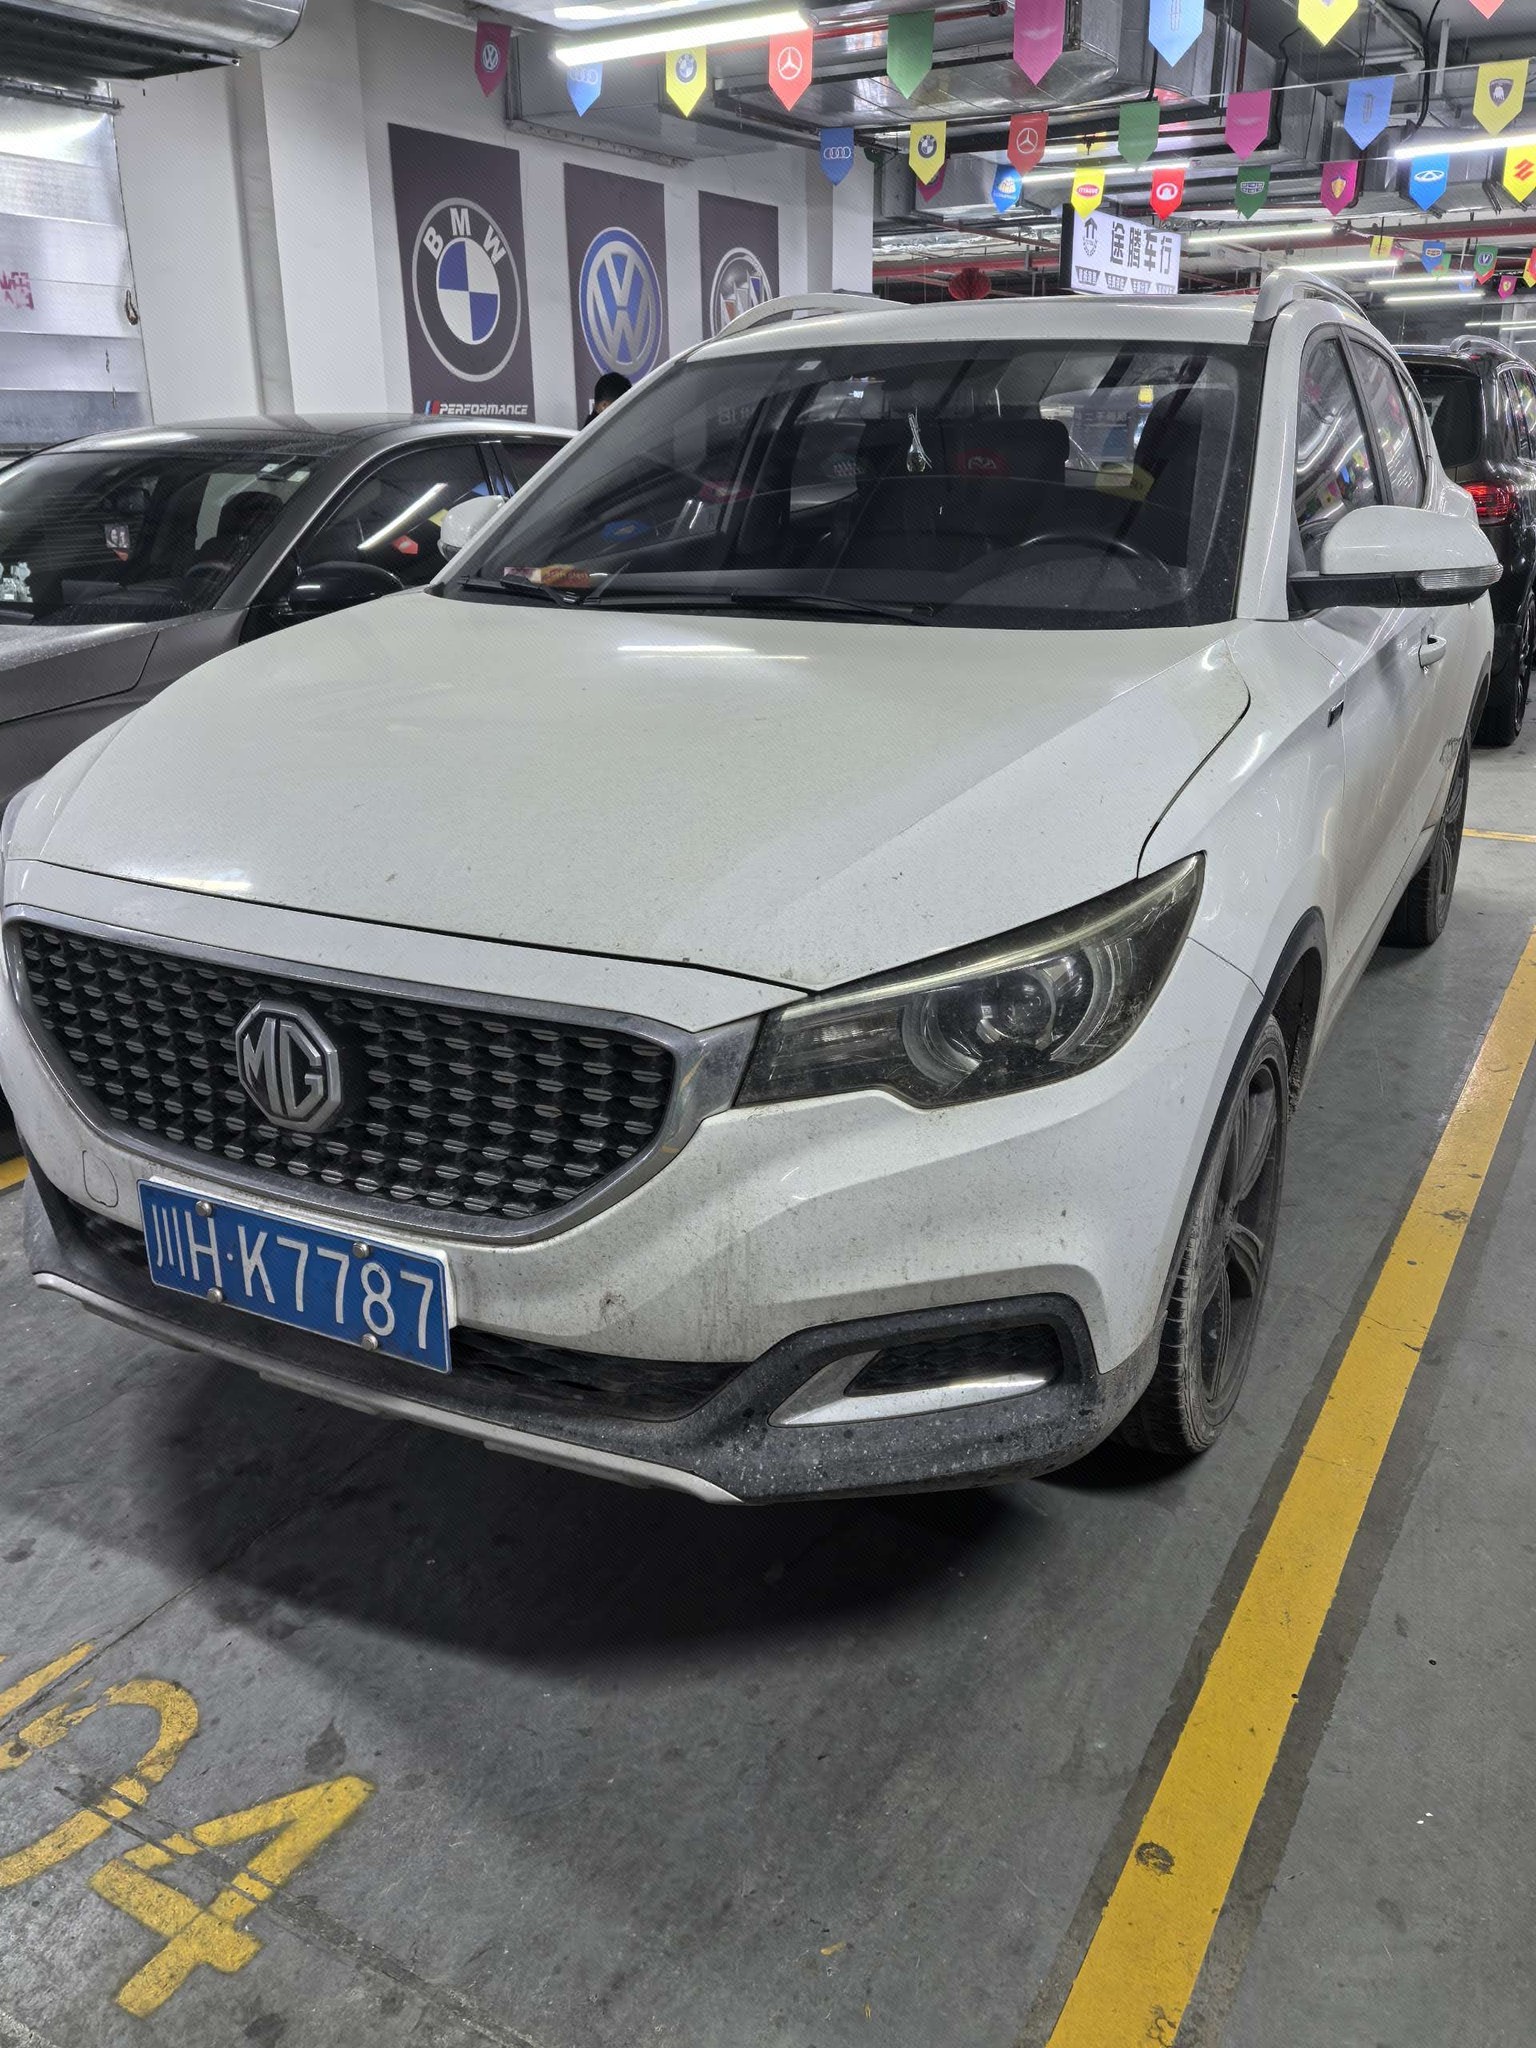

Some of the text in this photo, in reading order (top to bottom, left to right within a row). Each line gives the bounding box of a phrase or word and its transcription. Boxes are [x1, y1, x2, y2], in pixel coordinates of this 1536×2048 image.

[423, 207, 506, 265] BMW
[439, 402, 529, 416] PERFORMANCE
[243, 1017, 324, 1119] MG
